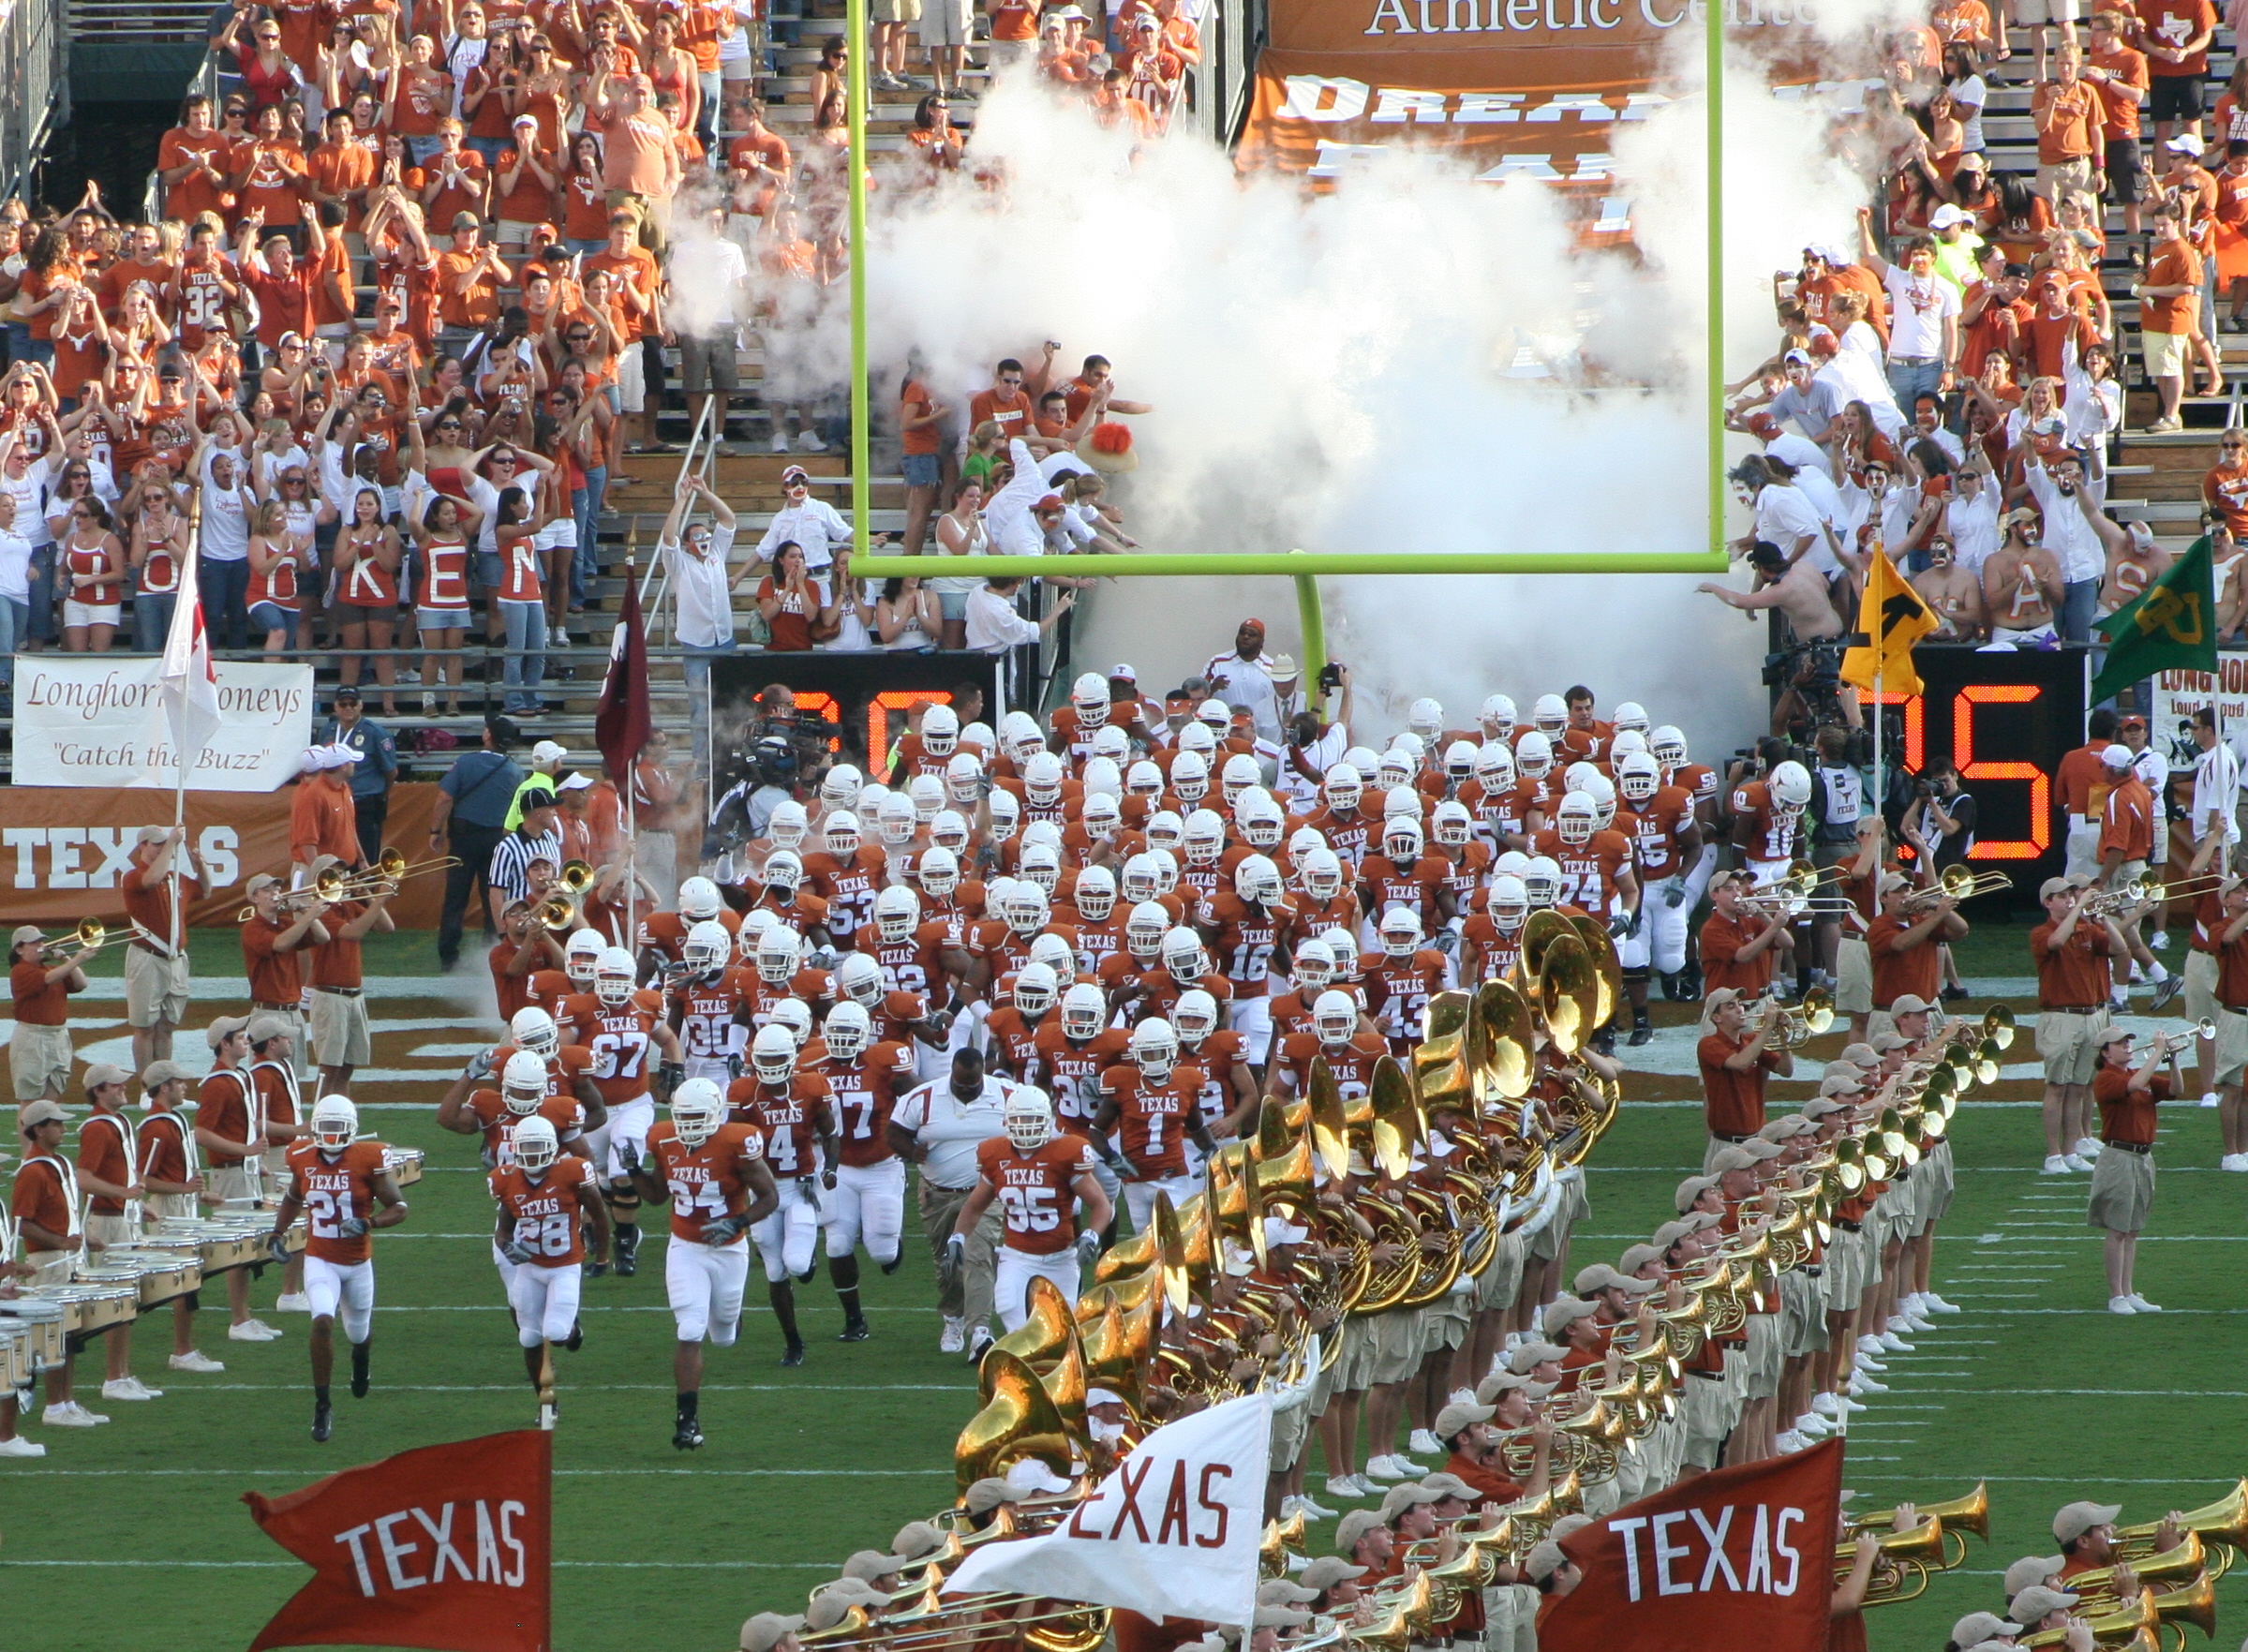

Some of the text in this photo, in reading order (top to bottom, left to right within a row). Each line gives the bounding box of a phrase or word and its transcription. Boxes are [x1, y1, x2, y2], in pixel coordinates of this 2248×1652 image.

[1363, 0, 1622, 35] Athletic
[186, 286, 223, 324] 32
[428, 545, 468, 603] E
[2009, 561, 2049, 619] A
[215, 673, 302, 726] oneys
[2171, 698, 2200, 716] Loud
[53, 741, 271, 771] "Catch the Buzz"
[1332, 827, 1368, 848] TEXAS
[1562, 860, 1599, 874] TEXAS
[835, 875, 870, 894] TEXAS
[1184, 872, 1217, 887] TEXAS
[1386, 886, 1421, 900] TEXAS
[828, 888, 877, 935] 53
[1241, 929, 1274, 944] TEXAS
[880, 948, 913, 965] TEXAS
[1387, 978, 1425, 995] TEXAS
[692, 1000, 728, 1014] TEXAS
[1377, 993, 1430, 1039] 43
[601, 1017, 639, 1033] TEXAS
[686, 1014, 734, 1057] 30
[590, 1032, 649, 1079] 67
[1057, 1060, 1096, 1076] TEXAS
[1139, 1096, 1179, 1113] TEXAS
[763, 1108, 803, 1125] TEXAS
[1145, 1112, 1166, 1156] 1
[767, 1124, 797, 1171] 4
[308, 1174, 350, 1190] TEXAS
[672, 1167, 710, 1183] TEXAS
[1004, 1168, 1045, 1185] TEXAS
[305, 1190, 354, 1239] 21
[520, 1198, 560, 1216] TEXAS
[998, 1186, 1060, 1233] 95
[514, 1213, 572, 1257] 28
[334, 1498, 526, 1598] TEXAS
[1608, 1503, 1805, 1603] TEXAS
